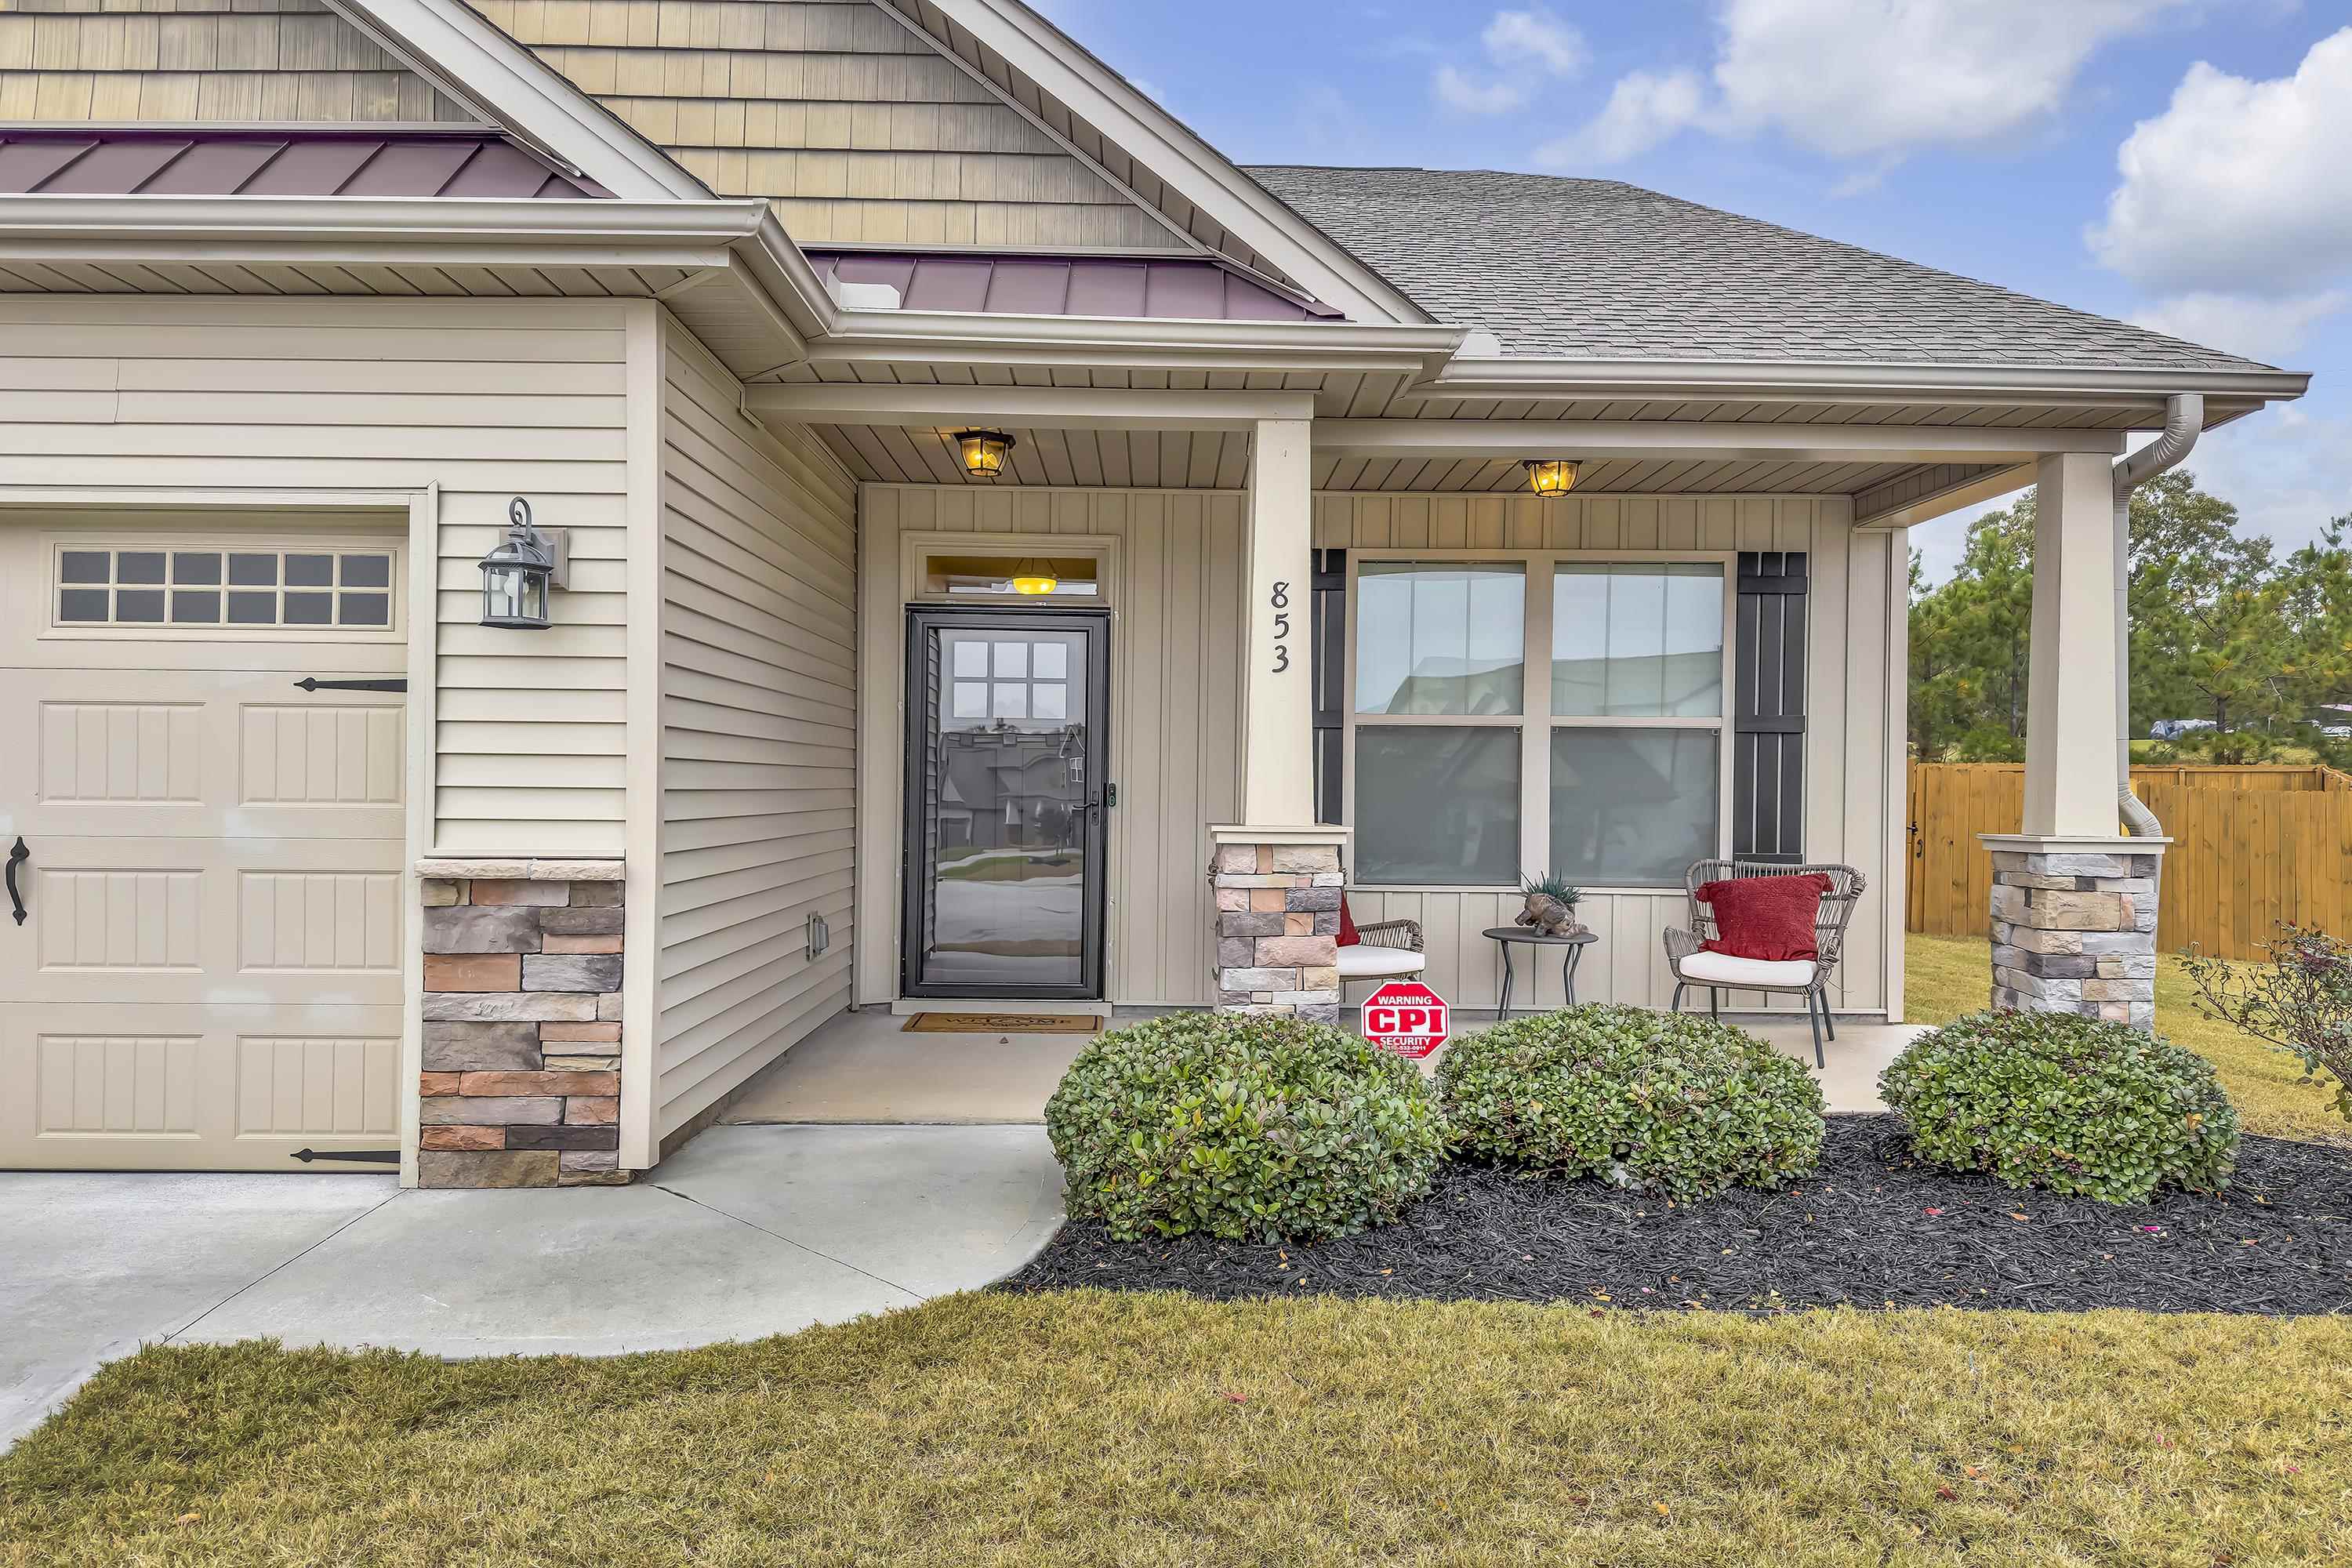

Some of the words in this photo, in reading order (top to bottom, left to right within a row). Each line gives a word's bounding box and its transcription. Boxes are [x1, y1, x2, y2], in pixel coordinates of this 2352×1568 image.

[1271, 581, 1289, 673] 853
[1377, 996, 1432, 1005] WARNING
[1368, 1008, 1443, 1033] CPI
[1380, 1036, 1431, 1046] SECURITY
